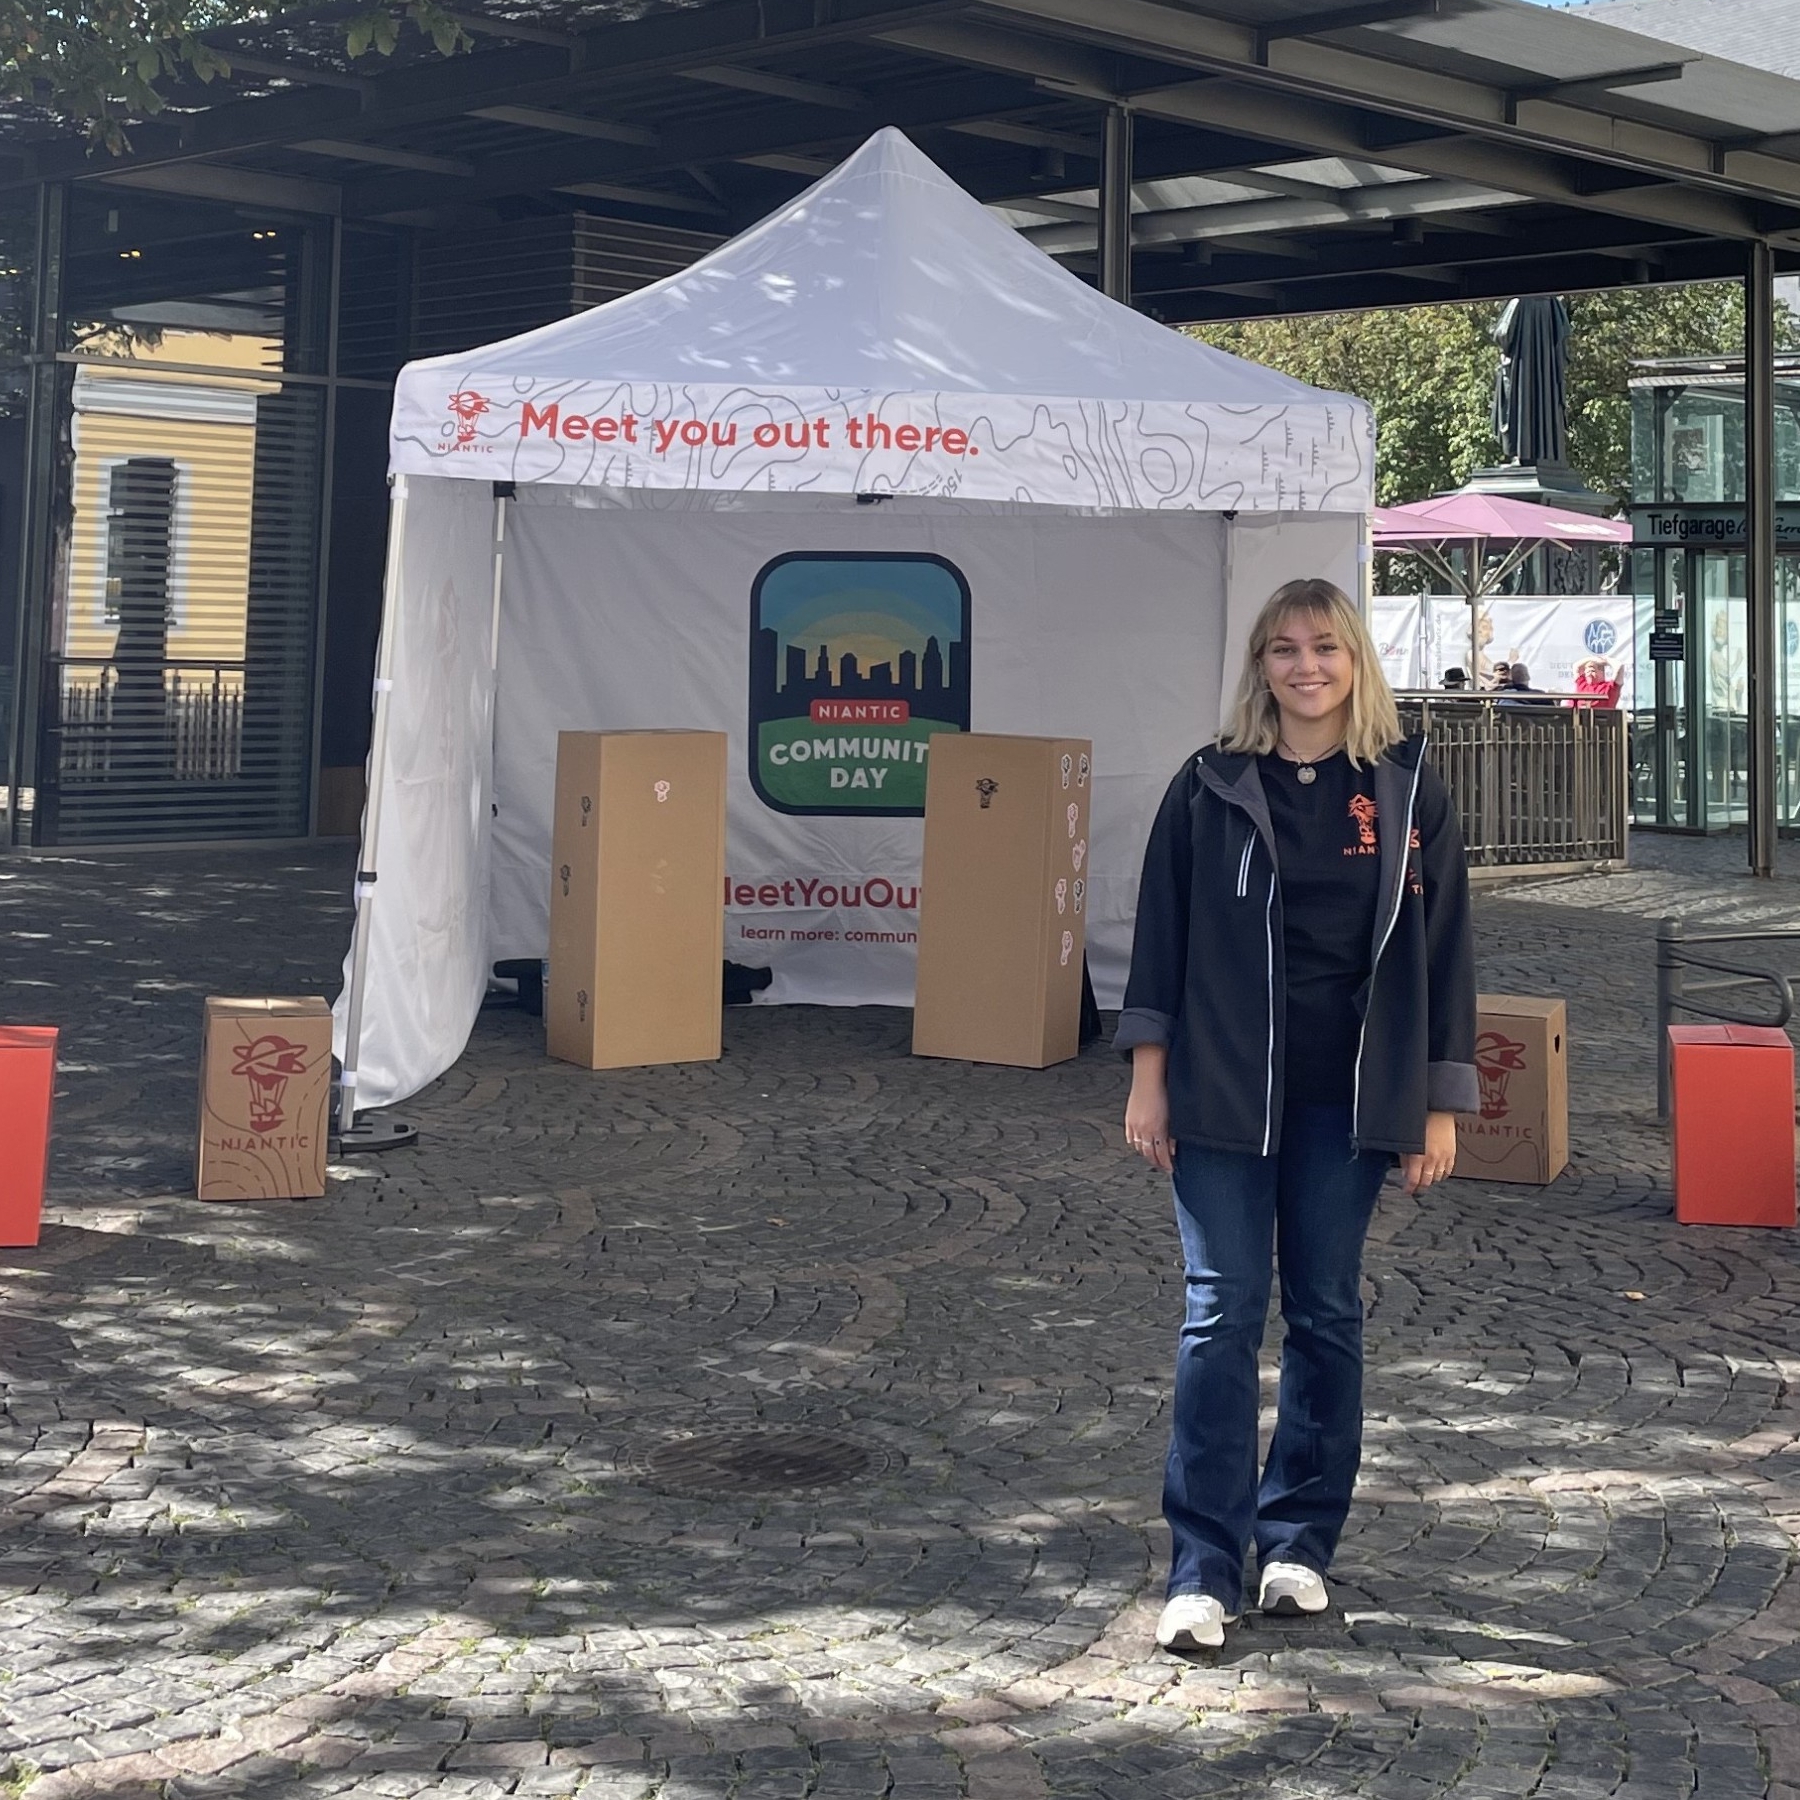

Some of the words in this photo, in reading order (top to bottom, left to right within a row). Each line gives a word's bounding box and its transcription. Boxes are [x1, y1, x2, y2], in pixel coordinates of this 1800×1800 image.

[520, 402, 639, 443] Meet
[654, 419, 737, 453] you
[753, 417, 831, 448] out
[846, 413, 979, 456] there.
[437, 442, 494, 454] NIANTIC
[1647, 513, 1736, 540] Tiefgarage
[818, 705, 901, 719] NIANTIC
[769, 737, 929, 766] COMMUNIT
[830, 767, 888, 789] DAY
[724, 877, 921, 909] eetYouOu
[741, 925, 785, 941] learn
[790, 930, 839, 941] more:
[844, 931, 918, 943] commun
[1456, 1121, 1533, 1139] NIANTIC
[221, 1136, 308, 1151] NIANTIC
